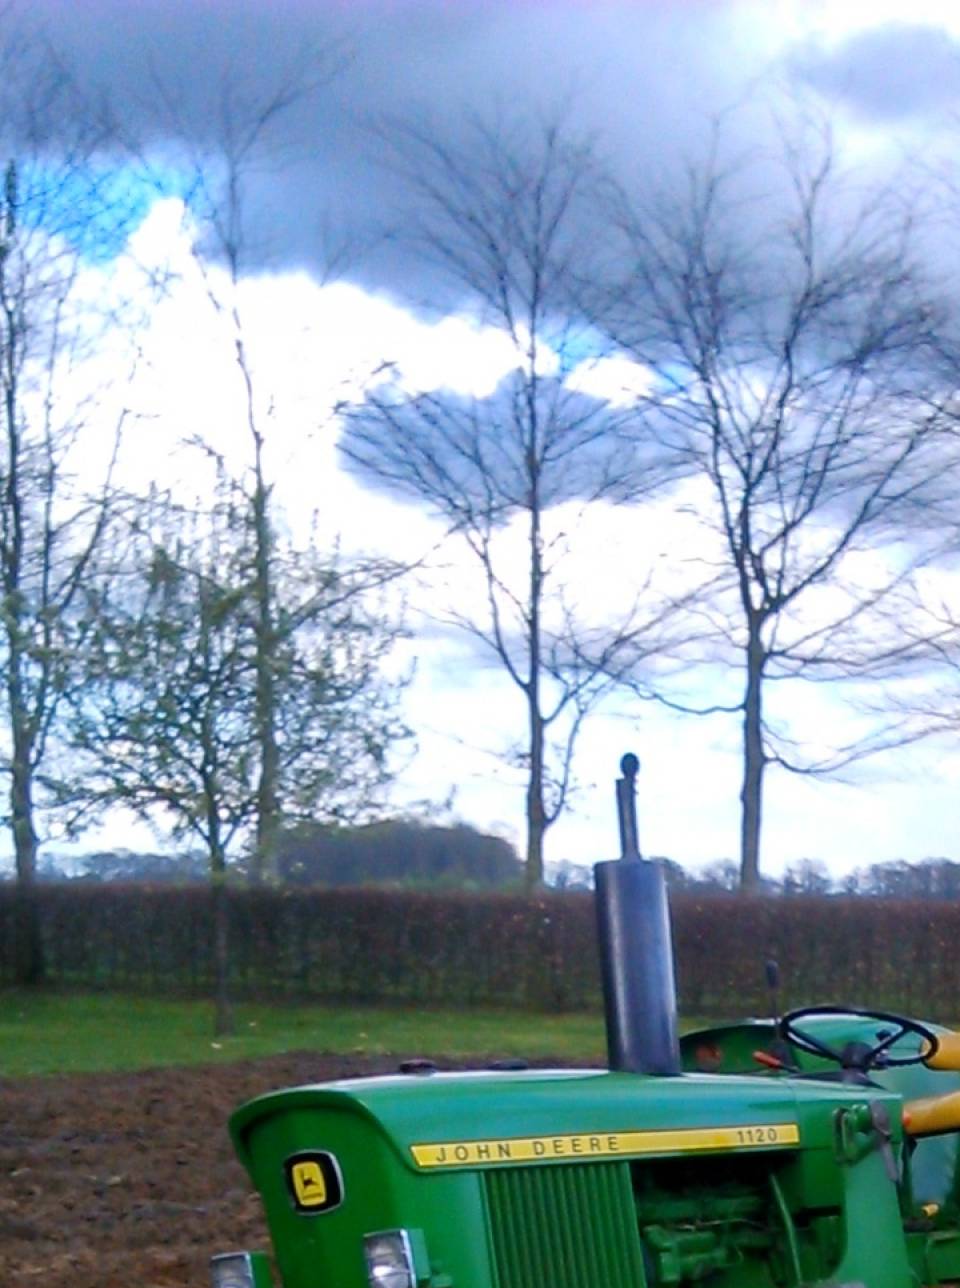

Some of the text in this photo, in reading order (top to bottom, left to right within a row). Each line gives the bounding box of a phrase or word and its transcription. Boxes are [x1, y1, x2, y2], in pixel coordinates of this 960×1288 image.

[436, 1128, 778, 1163] JOHN DEERE 1120
